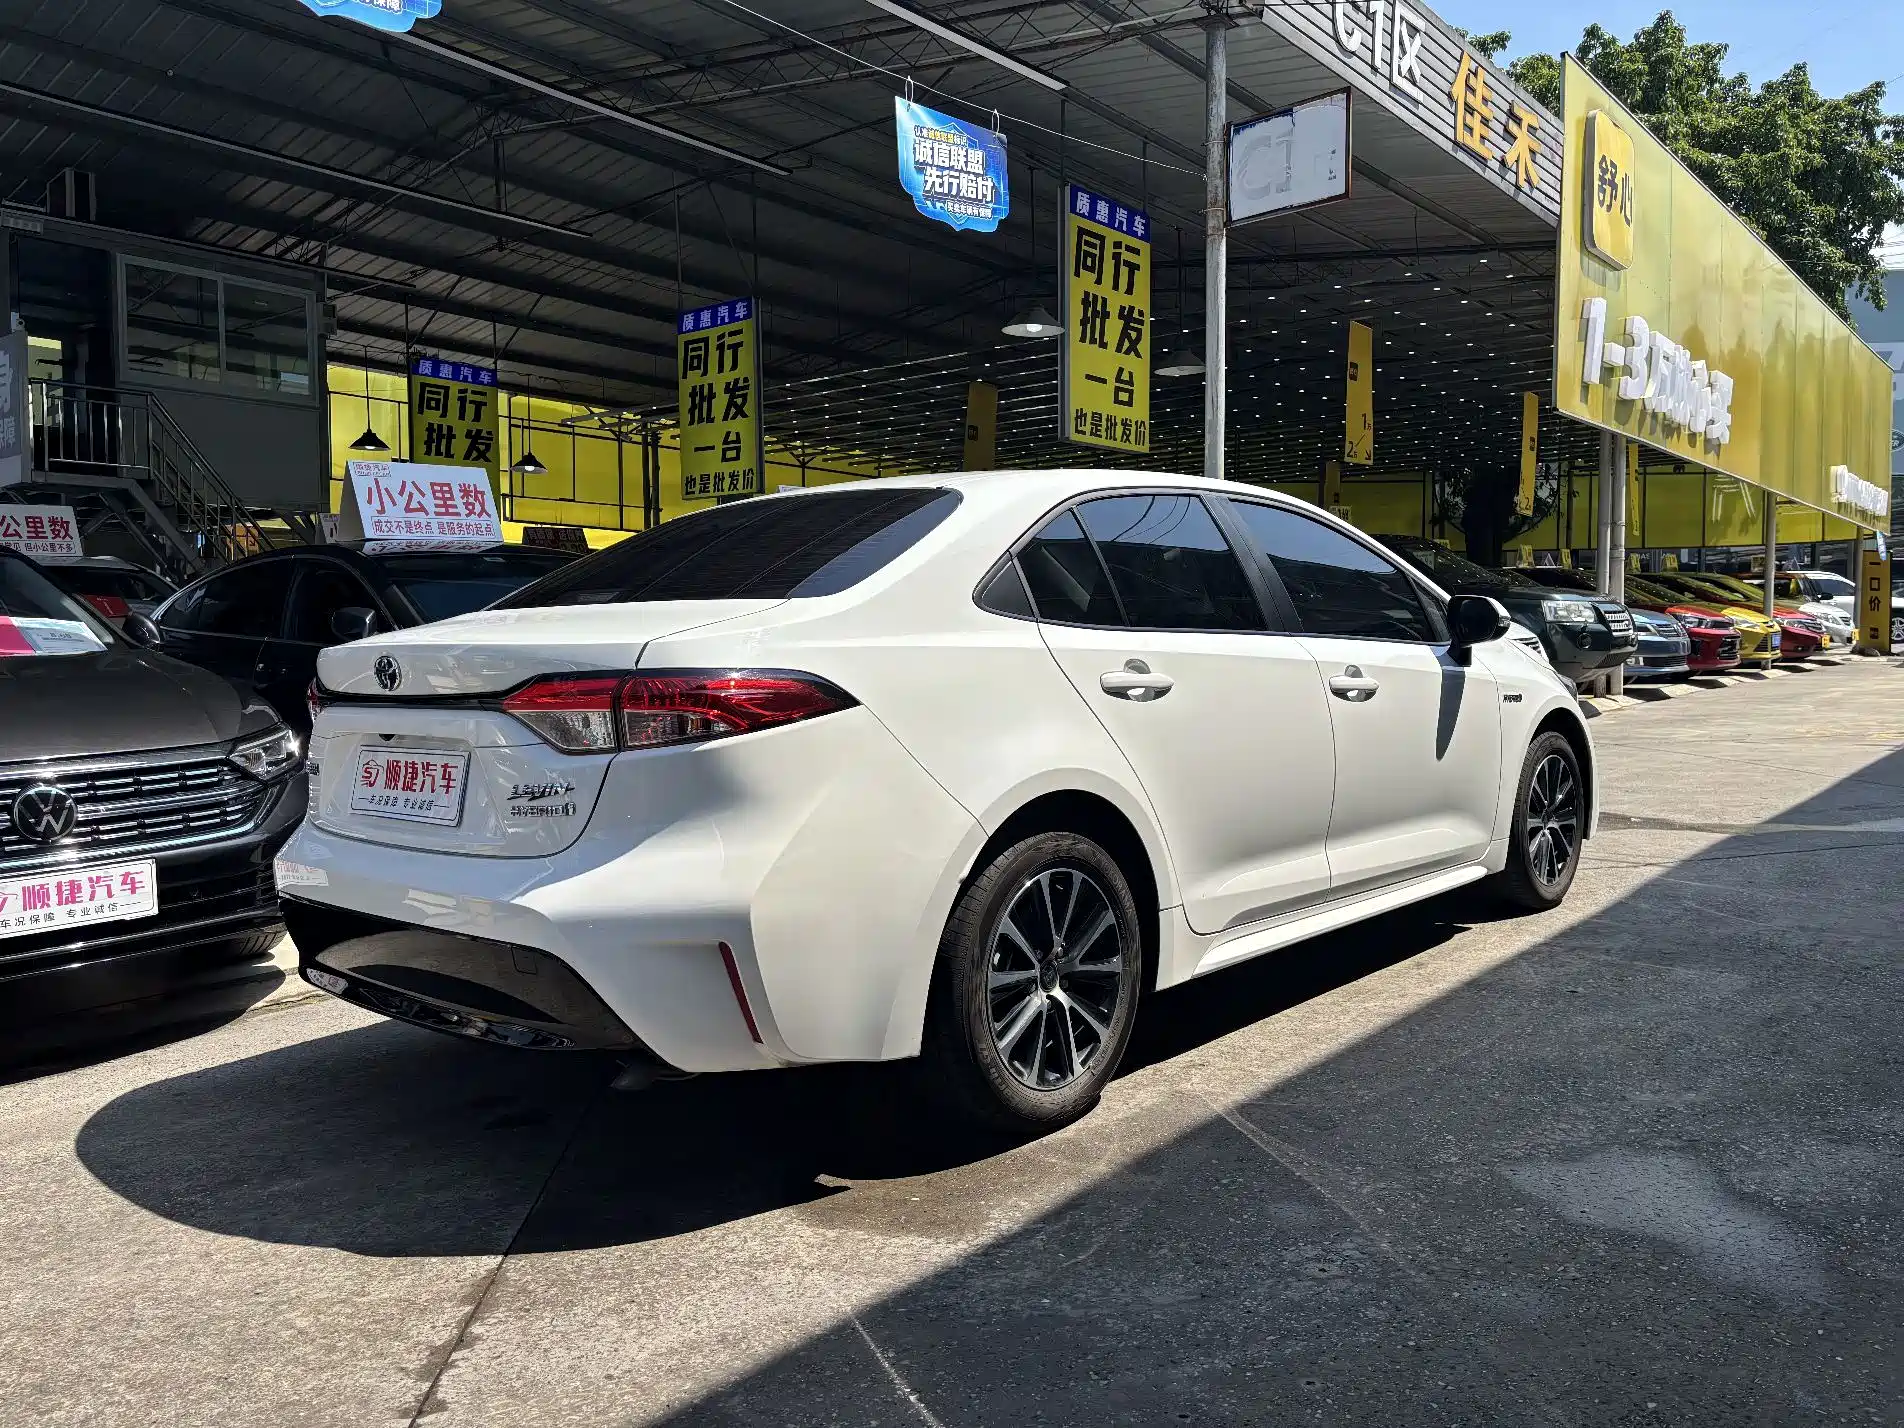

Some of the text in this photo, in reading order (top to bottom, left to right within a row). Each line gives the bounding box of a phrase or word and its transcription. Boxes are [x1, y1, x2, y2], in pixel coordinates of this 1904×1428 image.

[914, 140, 985, 174] 诚信联盟
[924, 167, 994, 202] 先行赔付
[1597, 154, 1633, 227] 舒心
[1076, 191, 1146, 237] 质惠汽车
[1073, 225, 1141, 295] 同行
[683, 302, 748, 331] 质惠汽车
[1078, 290, 1145, 359] 批发
[418, 360, 492, 384] 质惠汽车
[682, 328, 744, 380] 同行
[417, 382, 488, 423] 同行
[688, 376, 751, 426] 批发
[1084, 366, 1135, 408] 一台
[424, 422, 494, 462] 批发
[693, 430, 742, 463] 一台
[1074, 407, 1147, 447] 也是批发价
[366, 477, 492, 519] 小公里数
[684, 468, 755, 496] 也是批发价
[0, 515, 74, 540] 公里数
[24, 542, 73, 553] 但小公里不多
[373, 519, 495, 537] 成交不是终点 是服务的起点
[1868, 561, 1882, 612] 一口价
[383, 759, 459, 795] 顺捷汽车
[21, 871, 146, 912] 顺捷汽车
[0, 903, 118, 929] 车况保障 专业诚信
